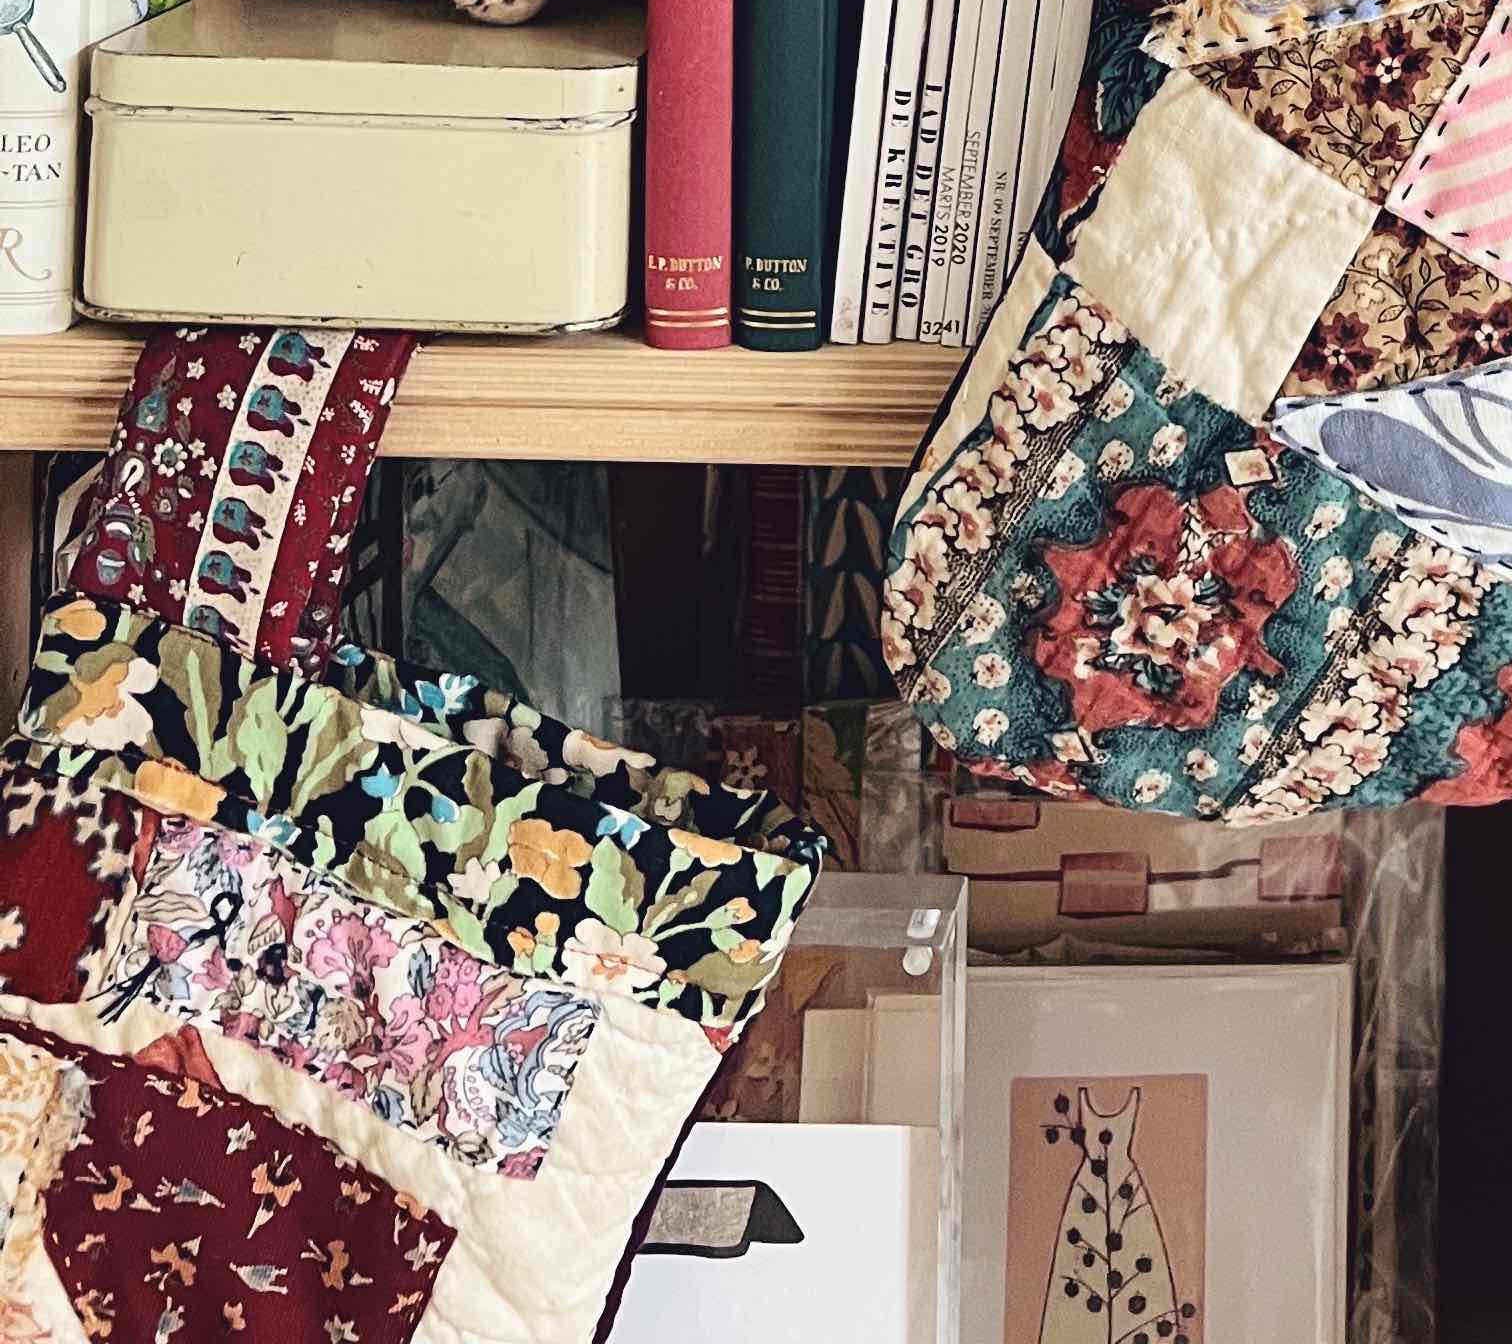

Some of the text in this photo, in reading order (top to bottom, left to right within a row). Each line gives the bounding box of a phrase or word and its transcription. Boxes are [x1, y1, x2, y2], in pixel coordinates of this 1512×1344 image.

[872, 147, 905, 316] KREATIVE
[931, 224, 949, 267] 2019
[951, 222, 970, 265] 2020
[981, 214, 1002, 301] SEPTEMBER
